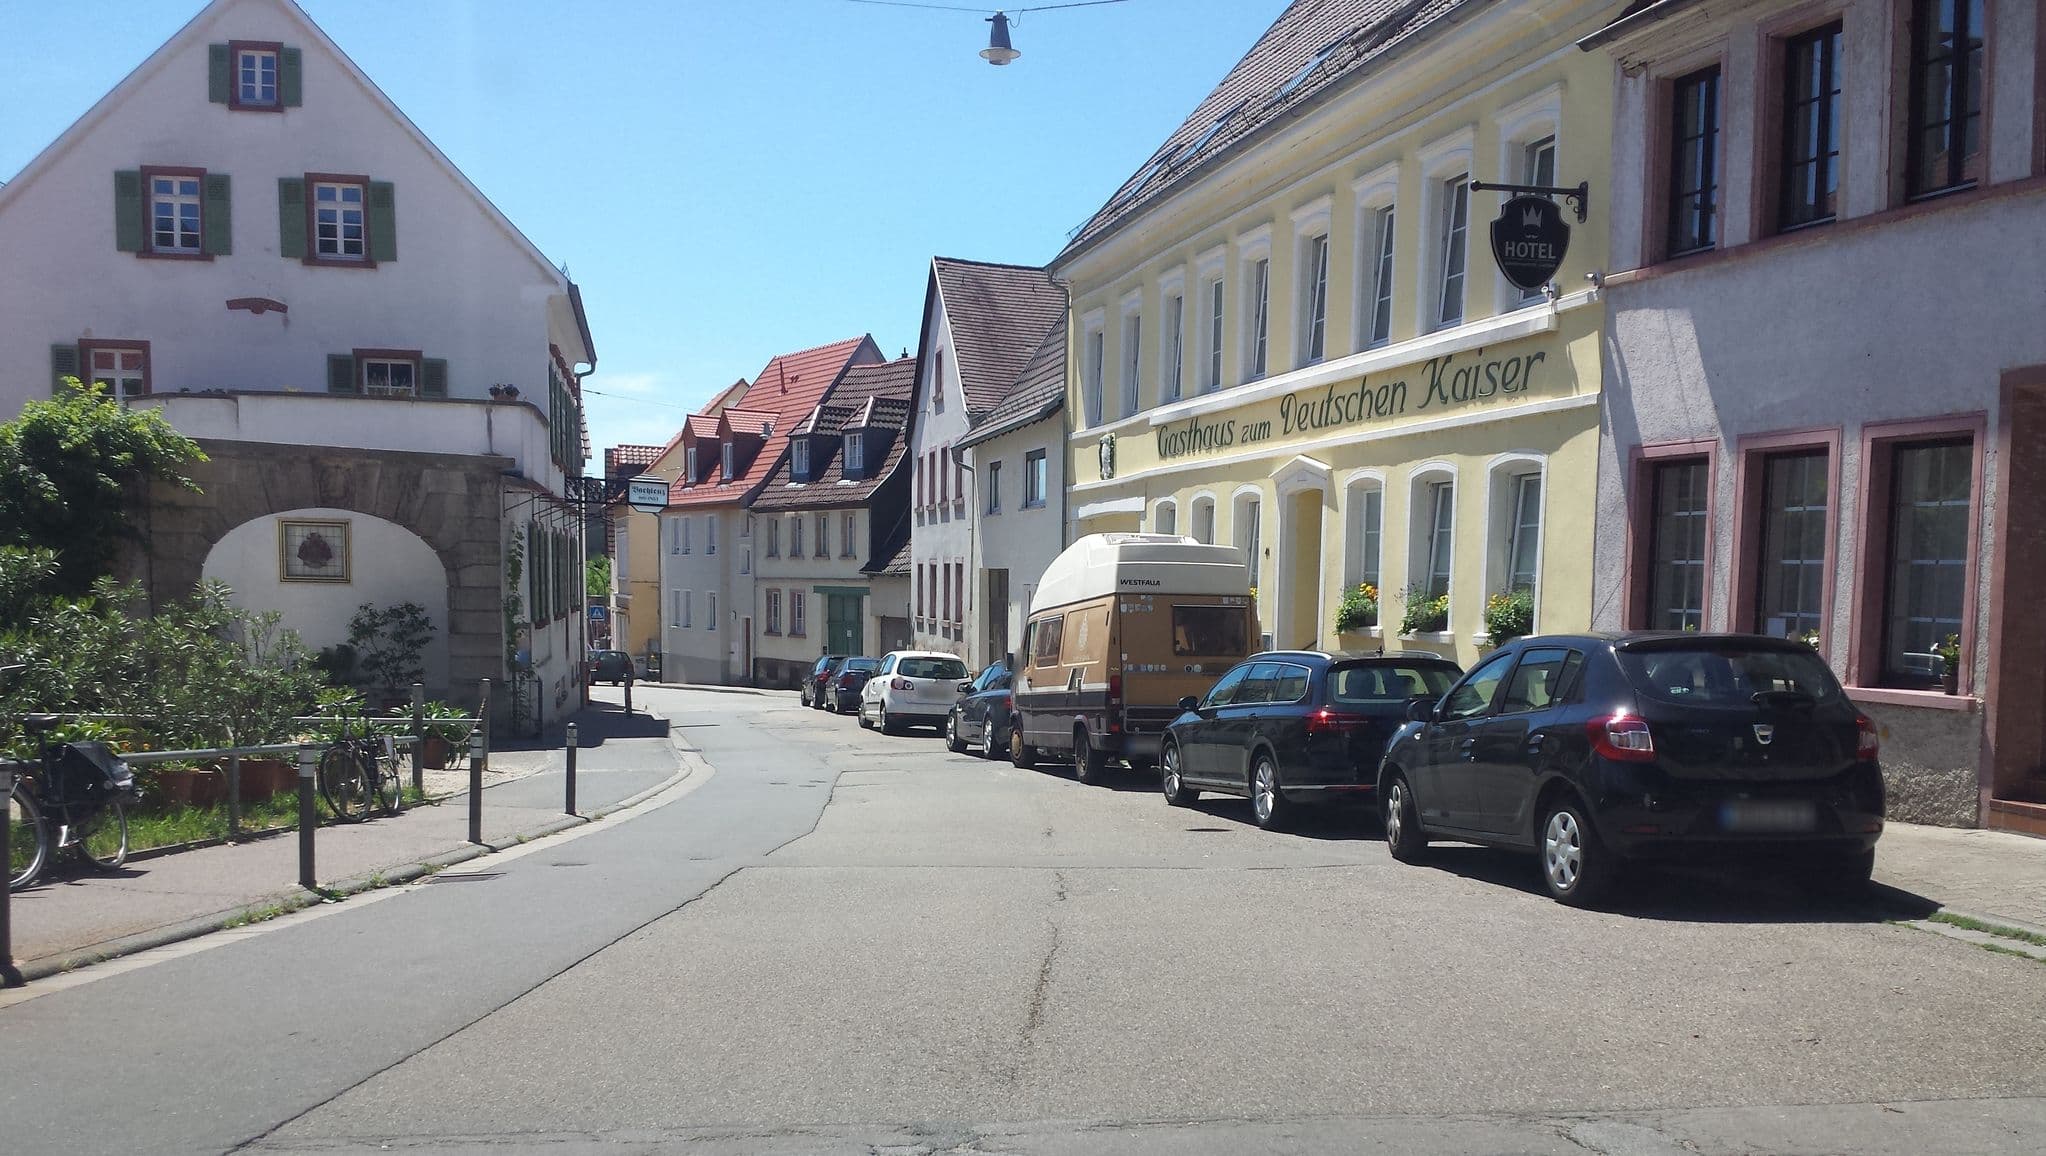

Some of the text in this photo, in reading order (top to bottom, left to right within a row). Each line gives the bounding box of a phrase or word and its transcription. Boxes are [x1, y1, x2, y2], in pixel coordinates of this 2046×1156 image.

[1504, 241, 1557, 259] HOTEL
[1158, 347, 1546, 458] Gasthaus zum Deutschen Kaiser
